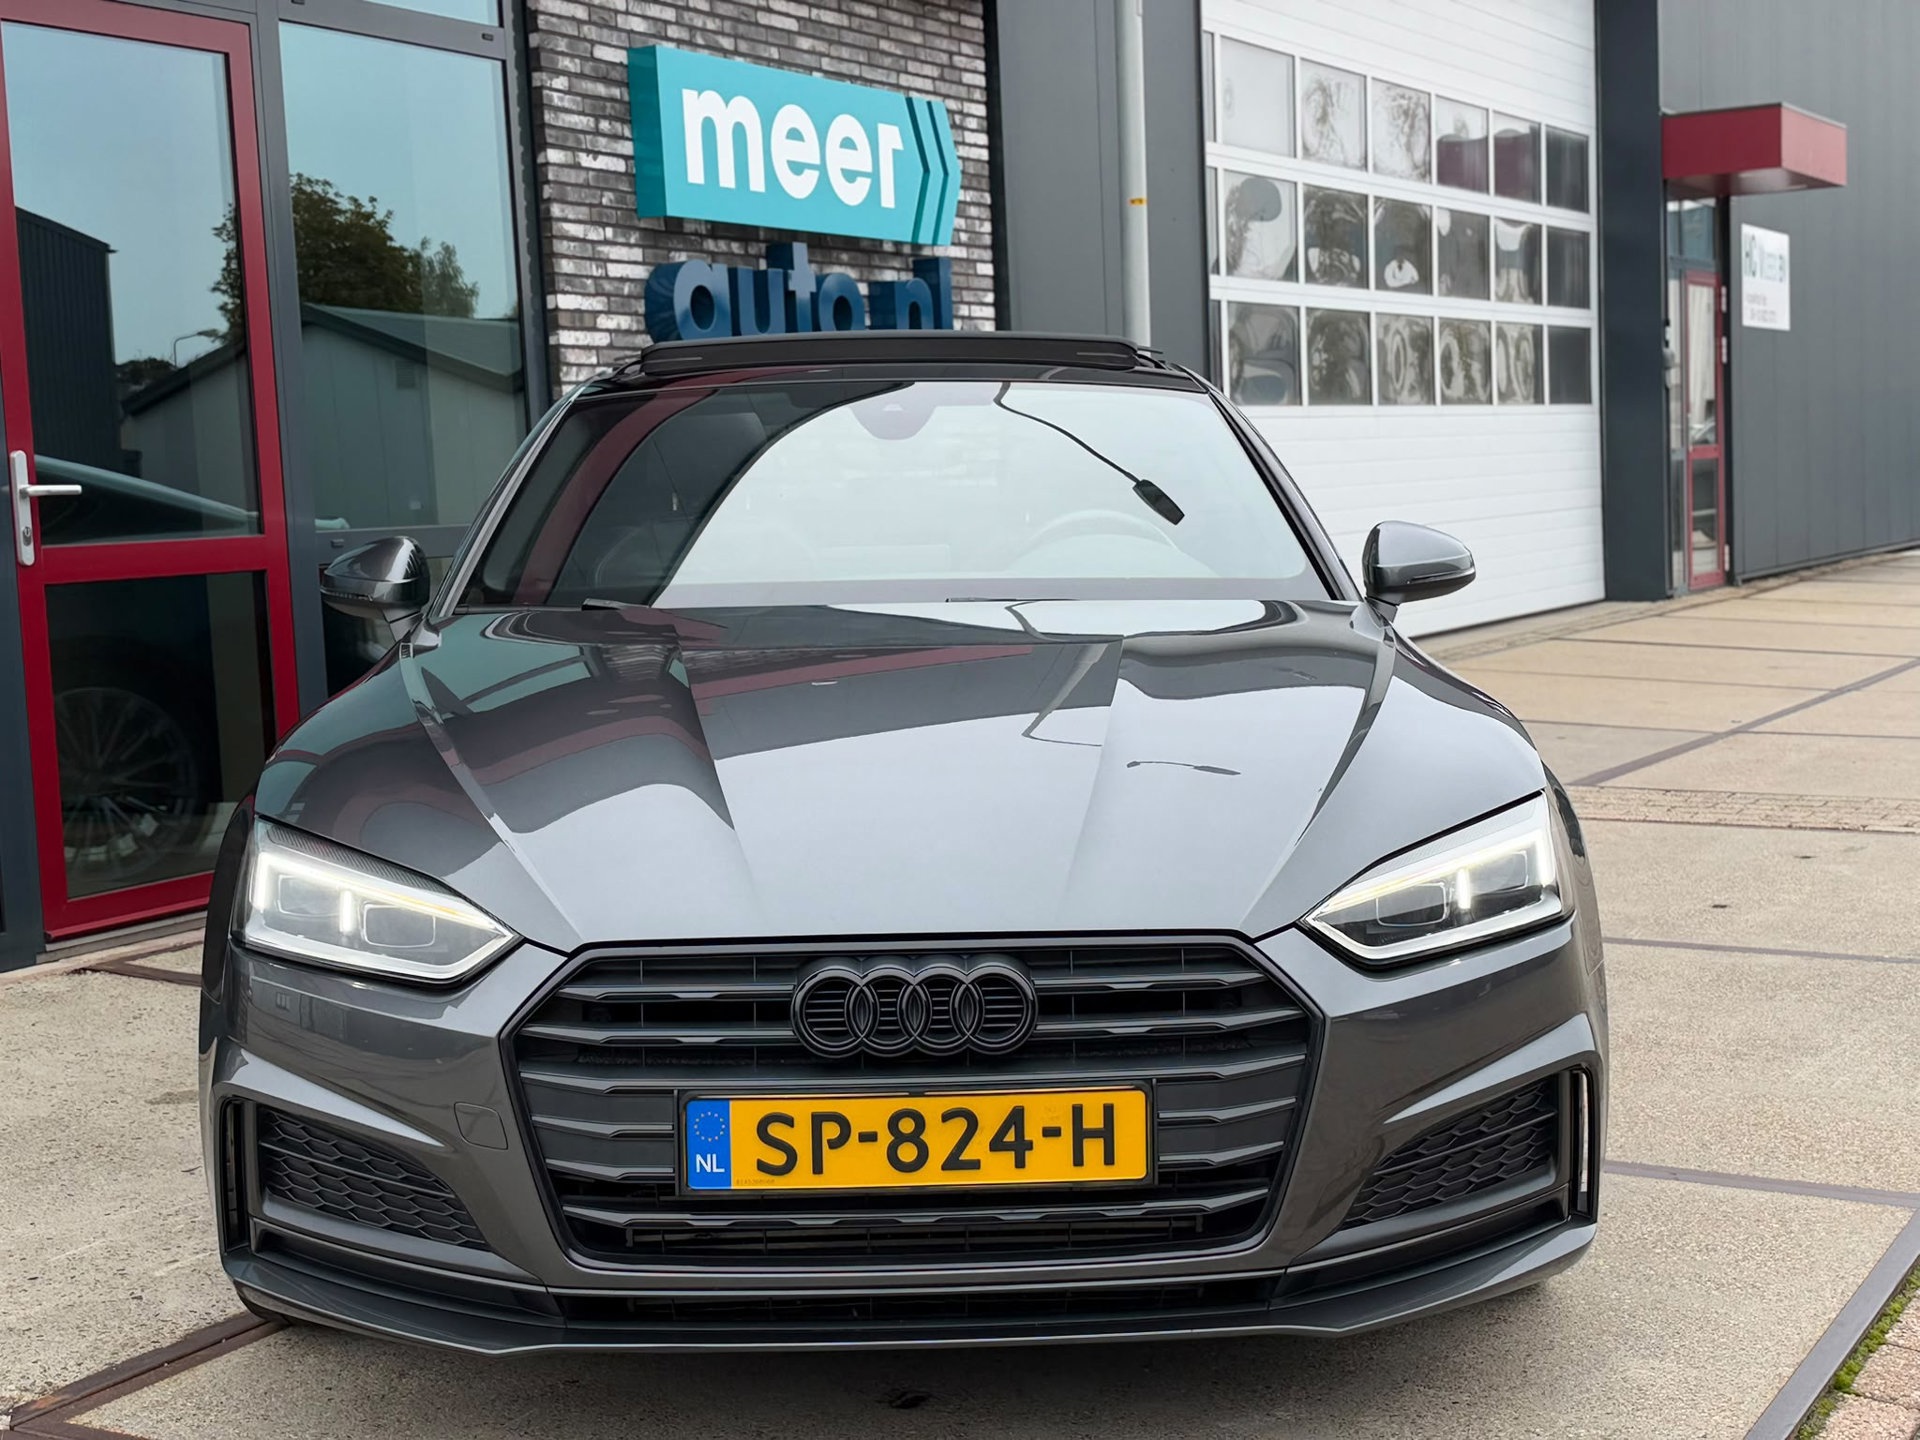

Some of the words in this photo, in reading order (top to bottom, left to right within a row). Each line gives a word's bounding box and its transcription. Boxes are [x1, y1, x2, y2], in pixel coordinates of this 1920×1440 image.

[682, 88, 904, 209] meer
[645, 242, 954, 340] autonl
[695, 1153, 725, 1173] NL
[756, 1102, 1115, 1176] SP-824-H
